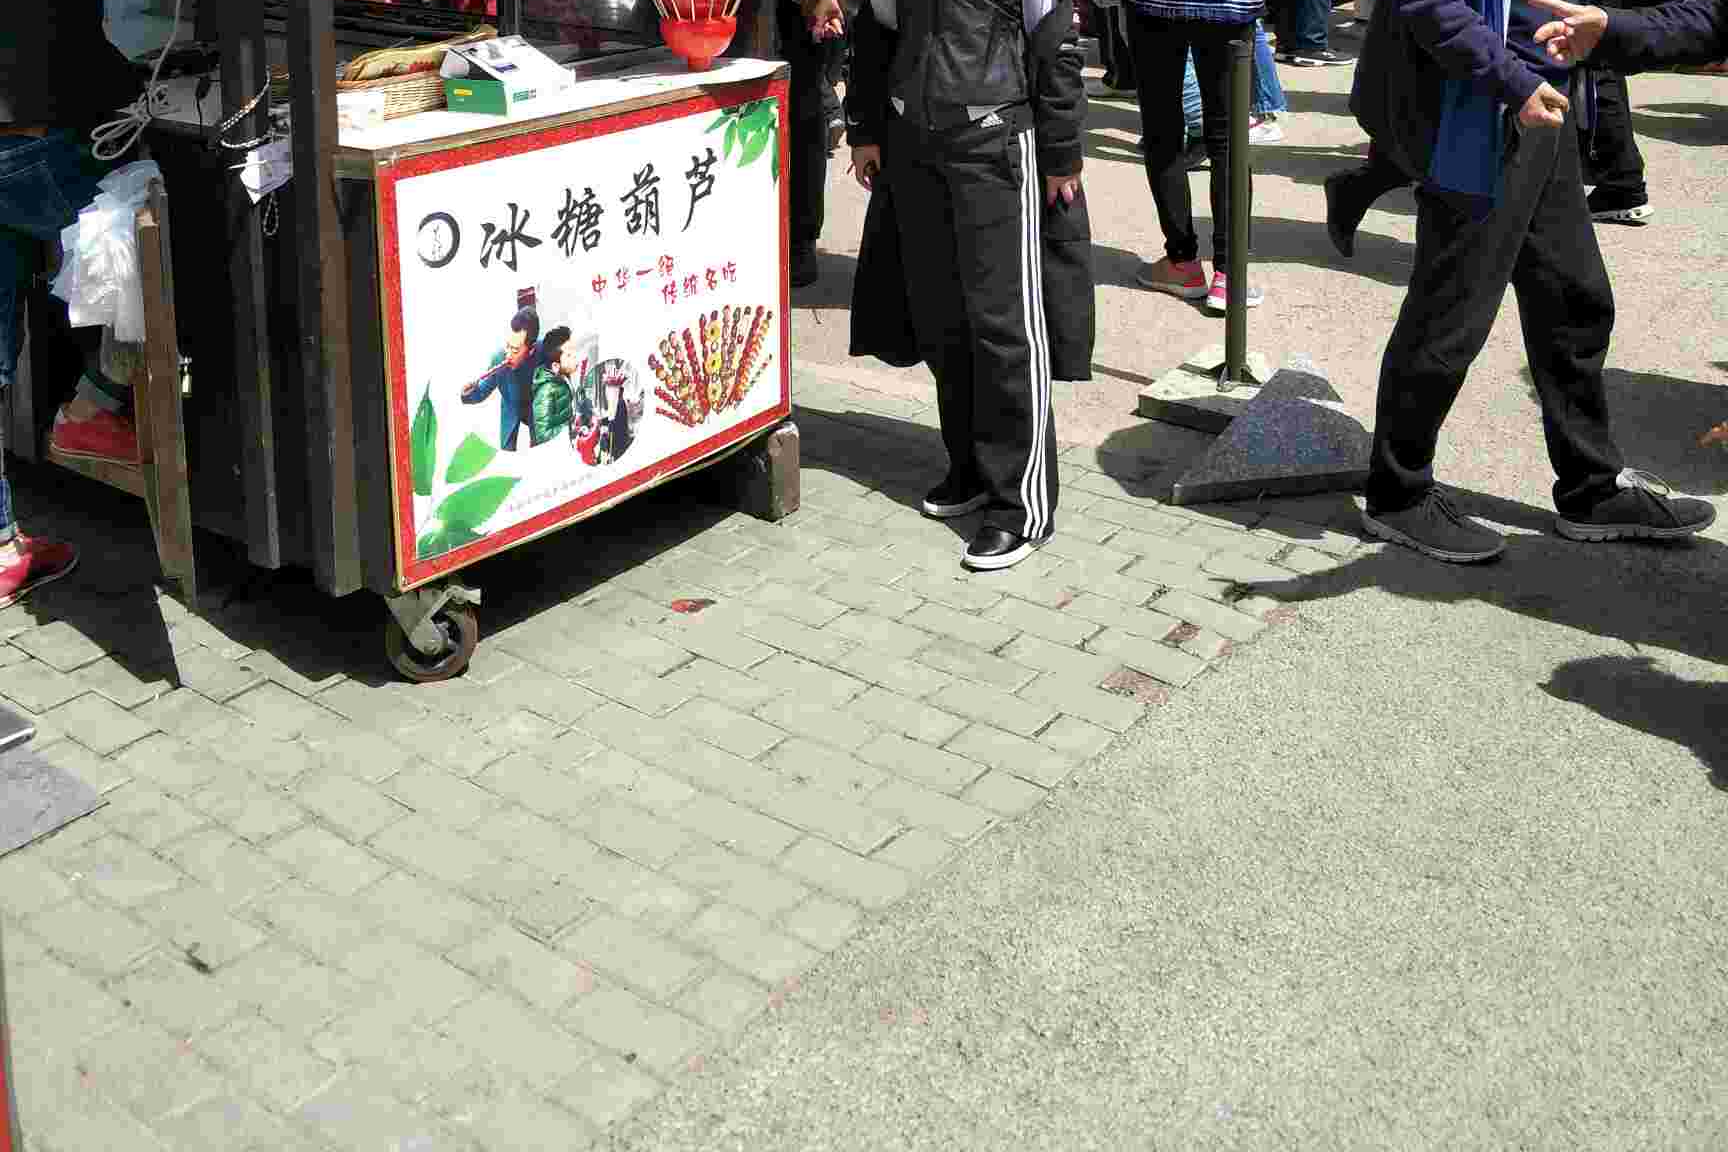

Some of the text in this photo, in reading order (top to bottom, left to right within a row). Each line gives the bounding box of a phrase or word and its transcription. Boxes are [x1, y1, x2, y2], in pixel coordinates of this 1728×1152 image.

[480, 148, 717, 272] 冰糖葫芦
[591, 255, 676, 300] 中华一绝
[661, 260, 738, 305] 传统名吃
